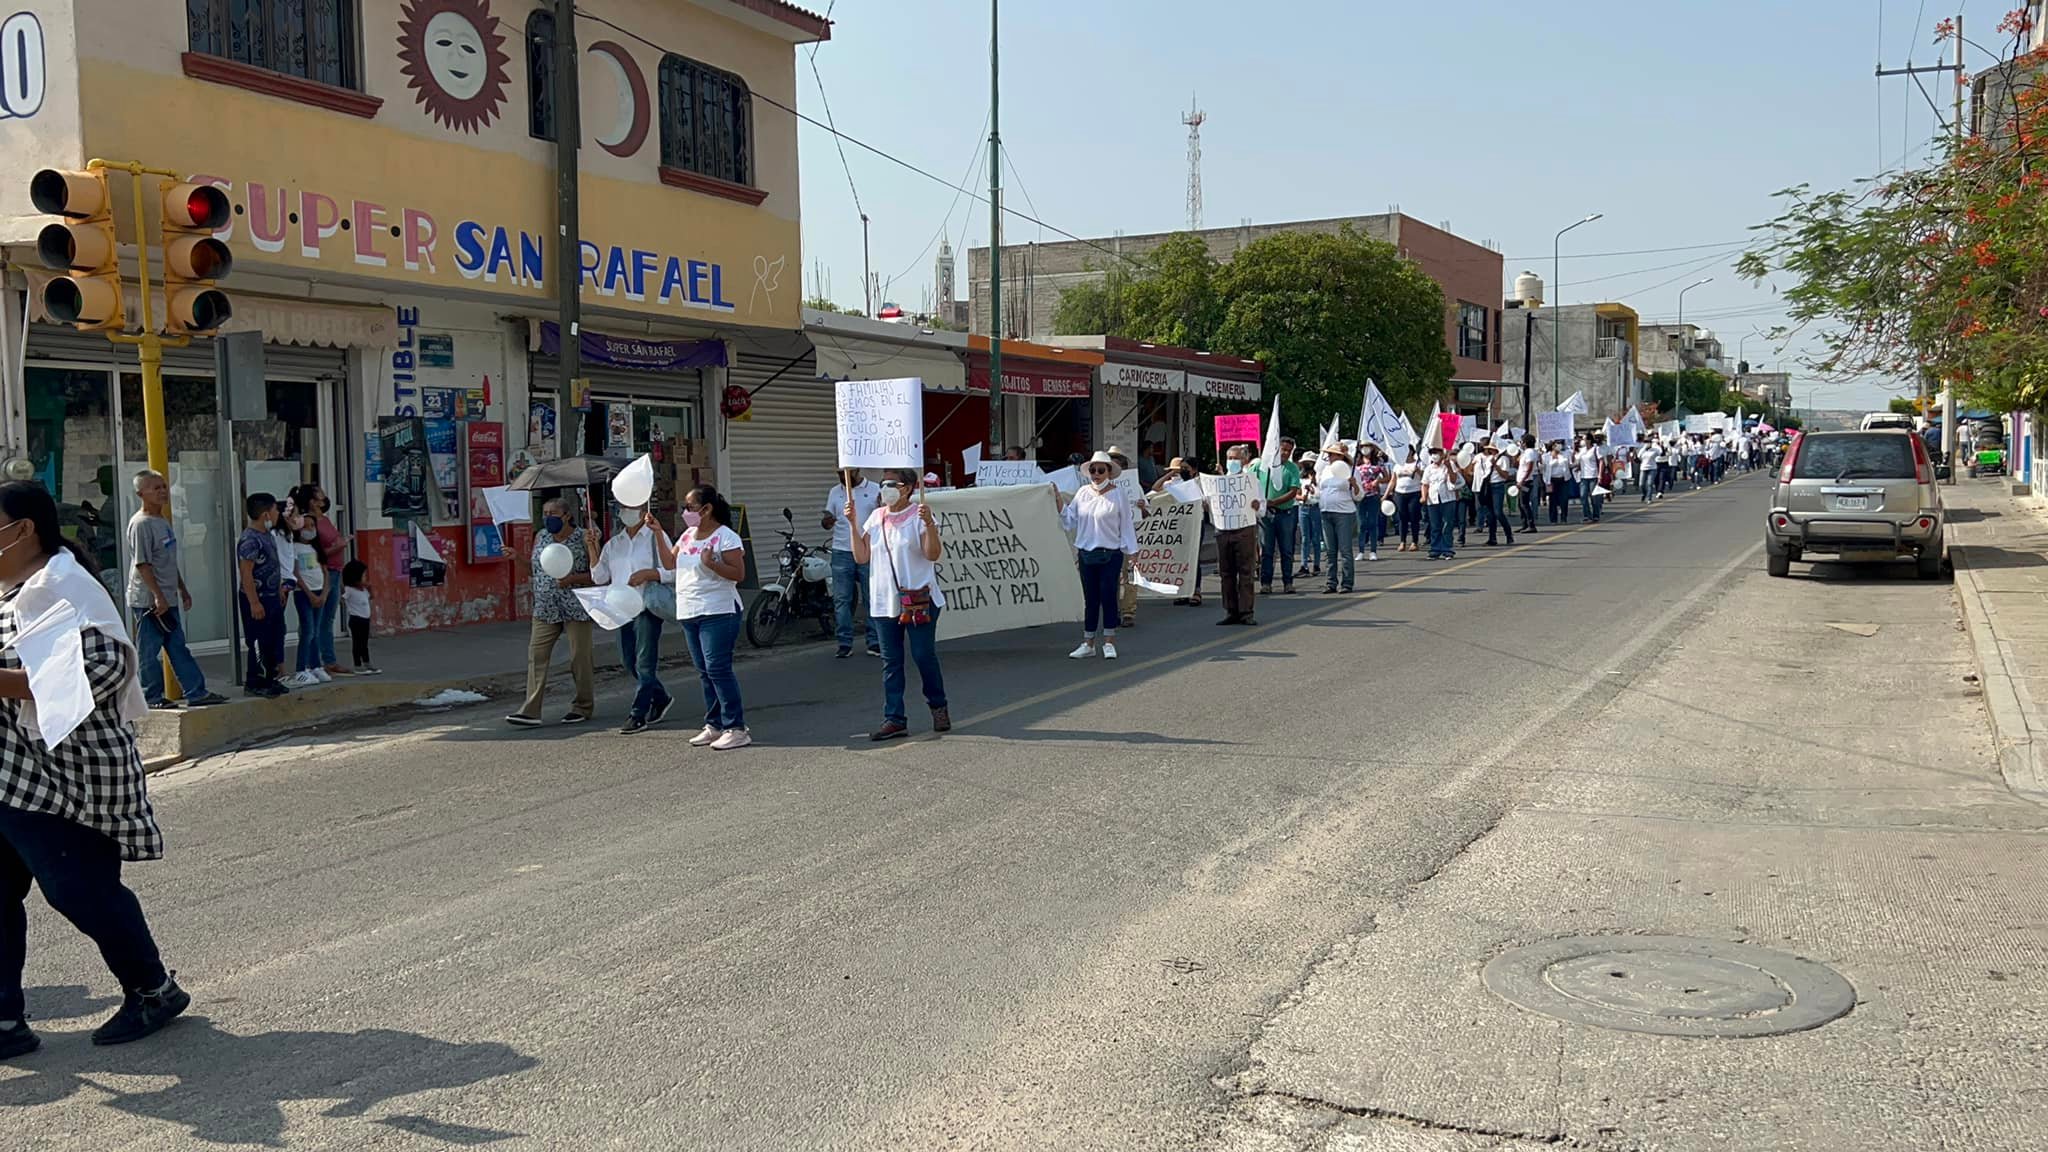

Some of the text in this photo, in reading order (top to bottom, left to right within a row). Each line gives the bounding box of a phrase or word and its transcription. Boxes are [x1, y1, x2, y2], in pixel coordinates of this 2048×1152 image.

[453, 219, 544, 289] SAN
[577, 239, 735, 313] RAFAEL
[606, 340, 677, 357] SUPER SAN RAFAEL
[1042, 378, 1072, 393] DENISSE
[1118, 367, 1169, 386] CARNICERIA
[1205, 379, 1246, 396] CREMERIA
[897, 392, 911, 405] EL
[1167, 504, 1194, 516] PAZ
[933, 508, 1014, 536] ATLAN
[942, 534, 1028, 560] MARCHA
[950, 562, 975, 583] LA
[975, 557, 1040, 580] VERDAD
[991, 584, 1002, 606] Y
[1011, 581, 1045, 605] PAZ
